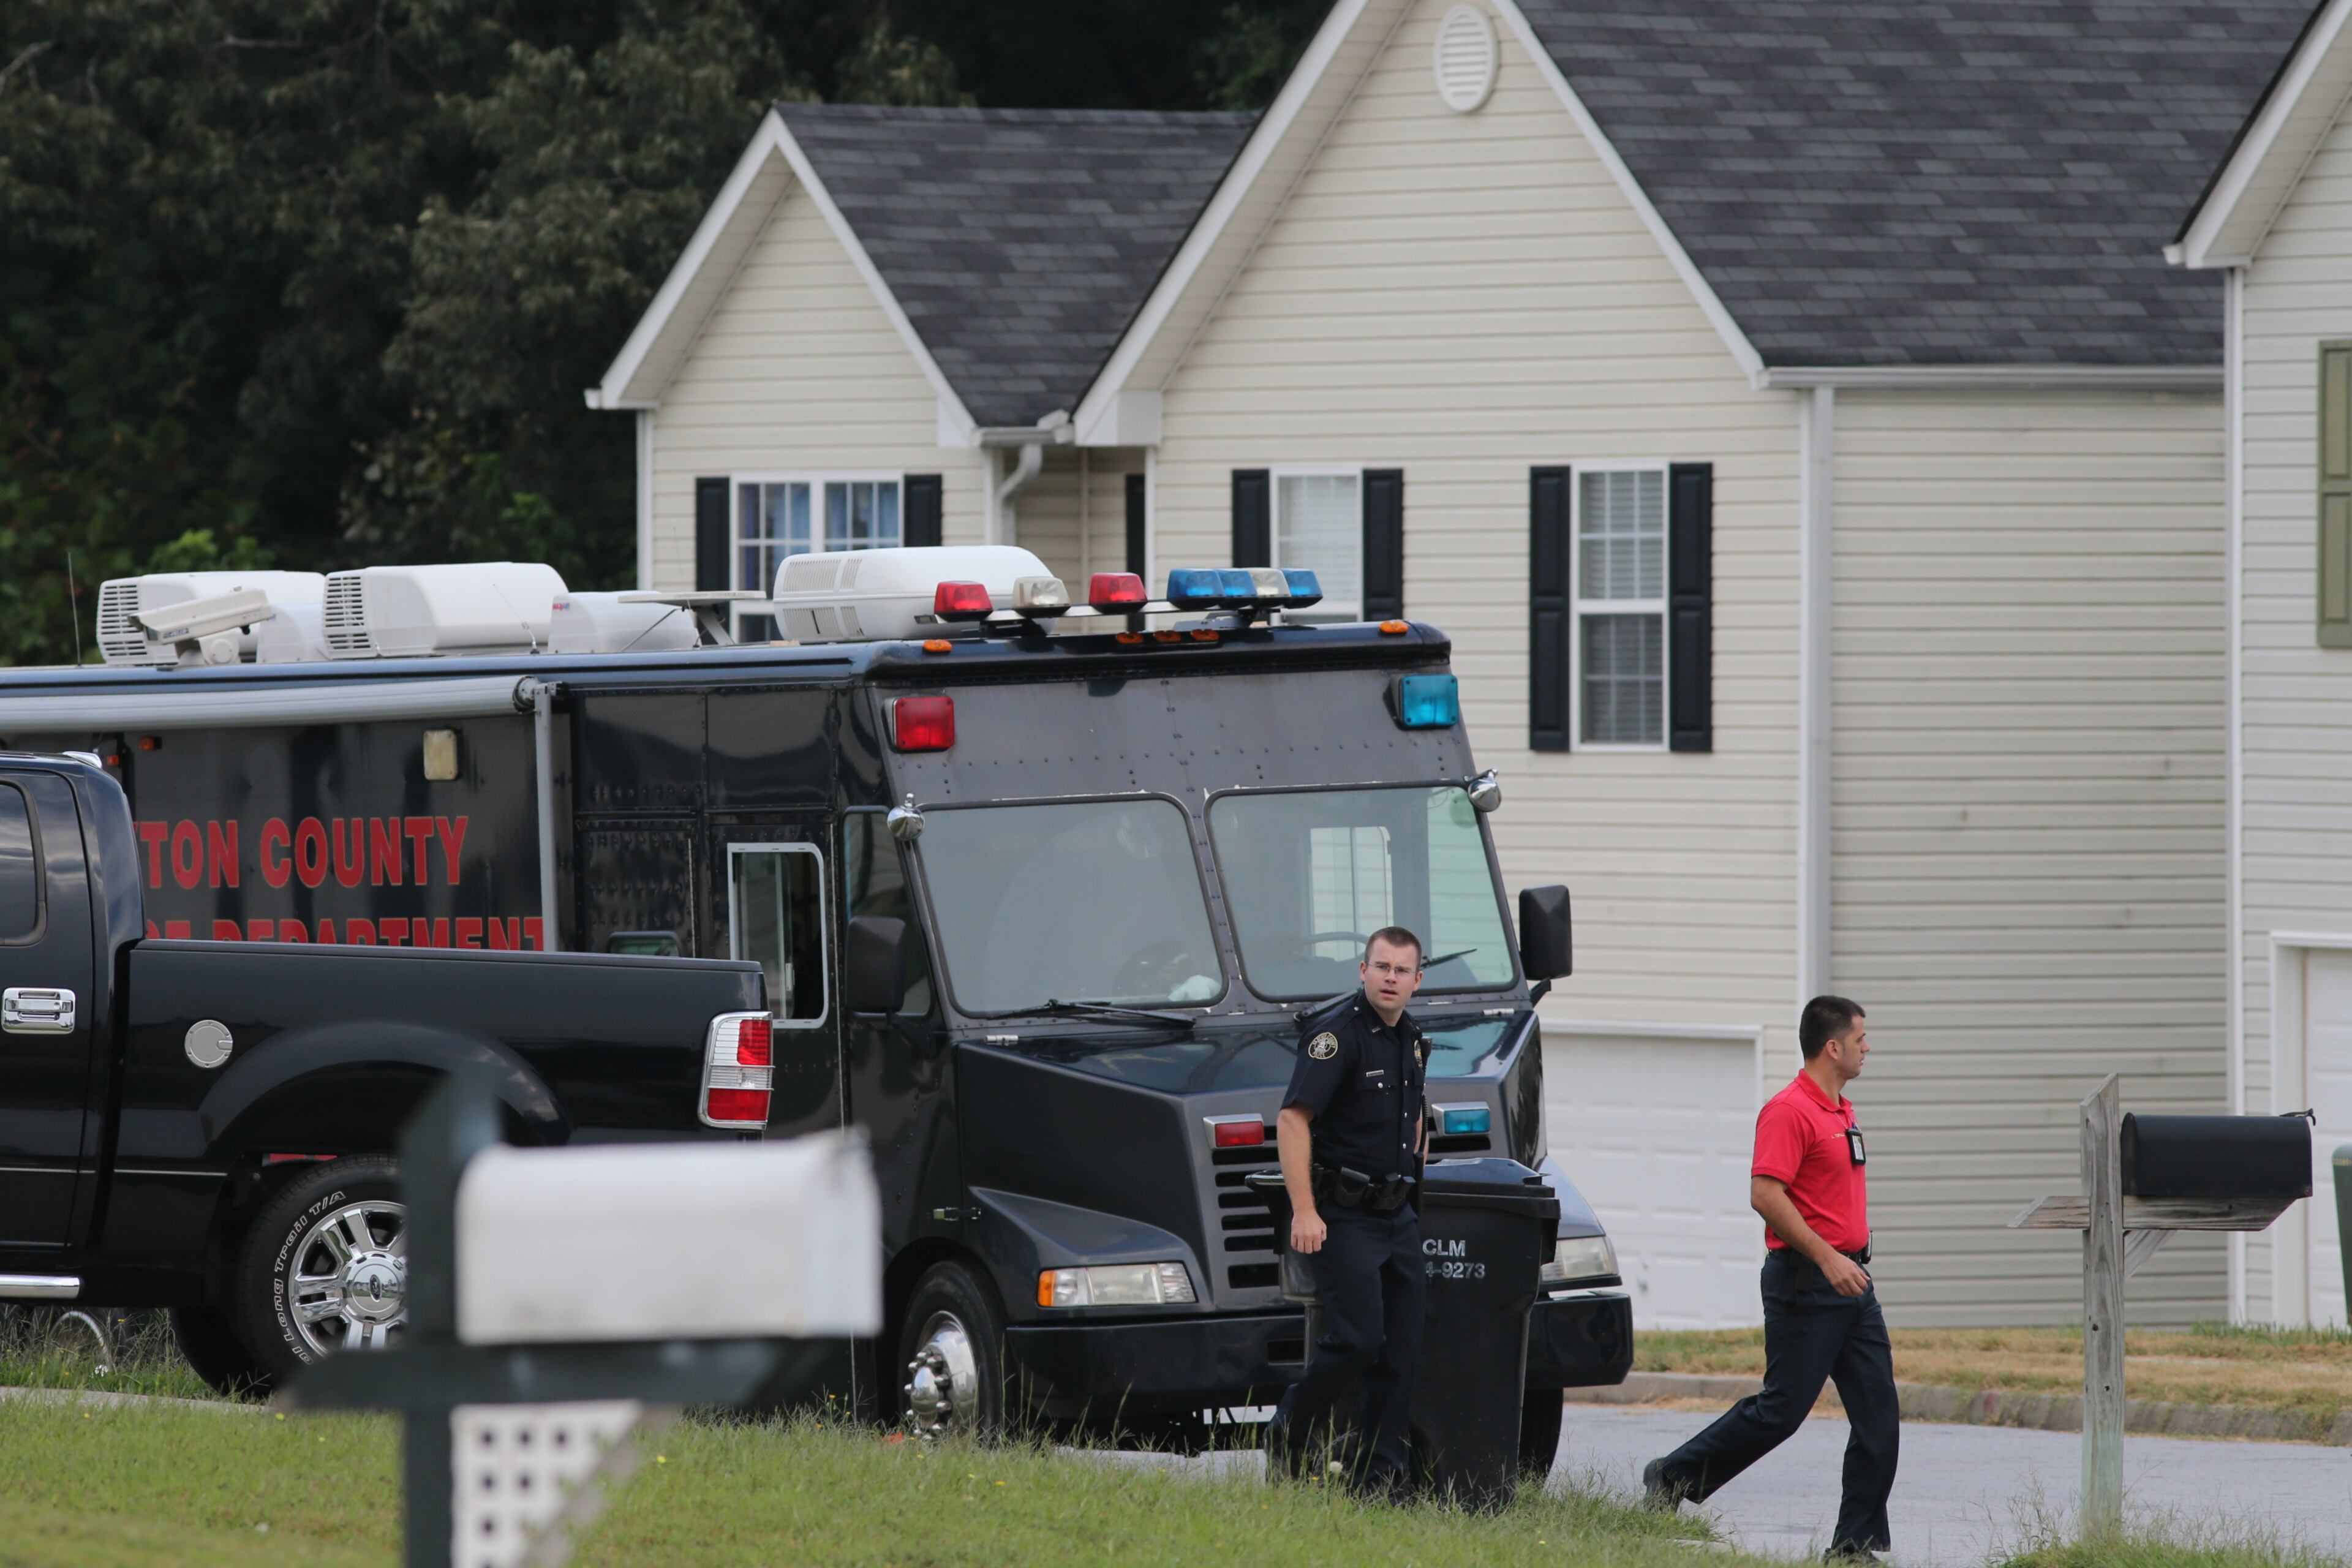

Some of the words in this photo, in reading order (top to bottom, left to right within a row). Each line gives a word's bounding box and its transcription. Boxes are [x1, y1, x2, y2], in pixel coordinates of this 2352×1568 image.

[133, 820, 239, 889] TON
[259, 816, 469, 889] COUNTY
[309, 1191, 346, 1216] T/A
[274, 1215, 308, 1273] Trail
[1422, 1238, 1466, 1256] CLM
[273, 1278, 295, 1341] Long
